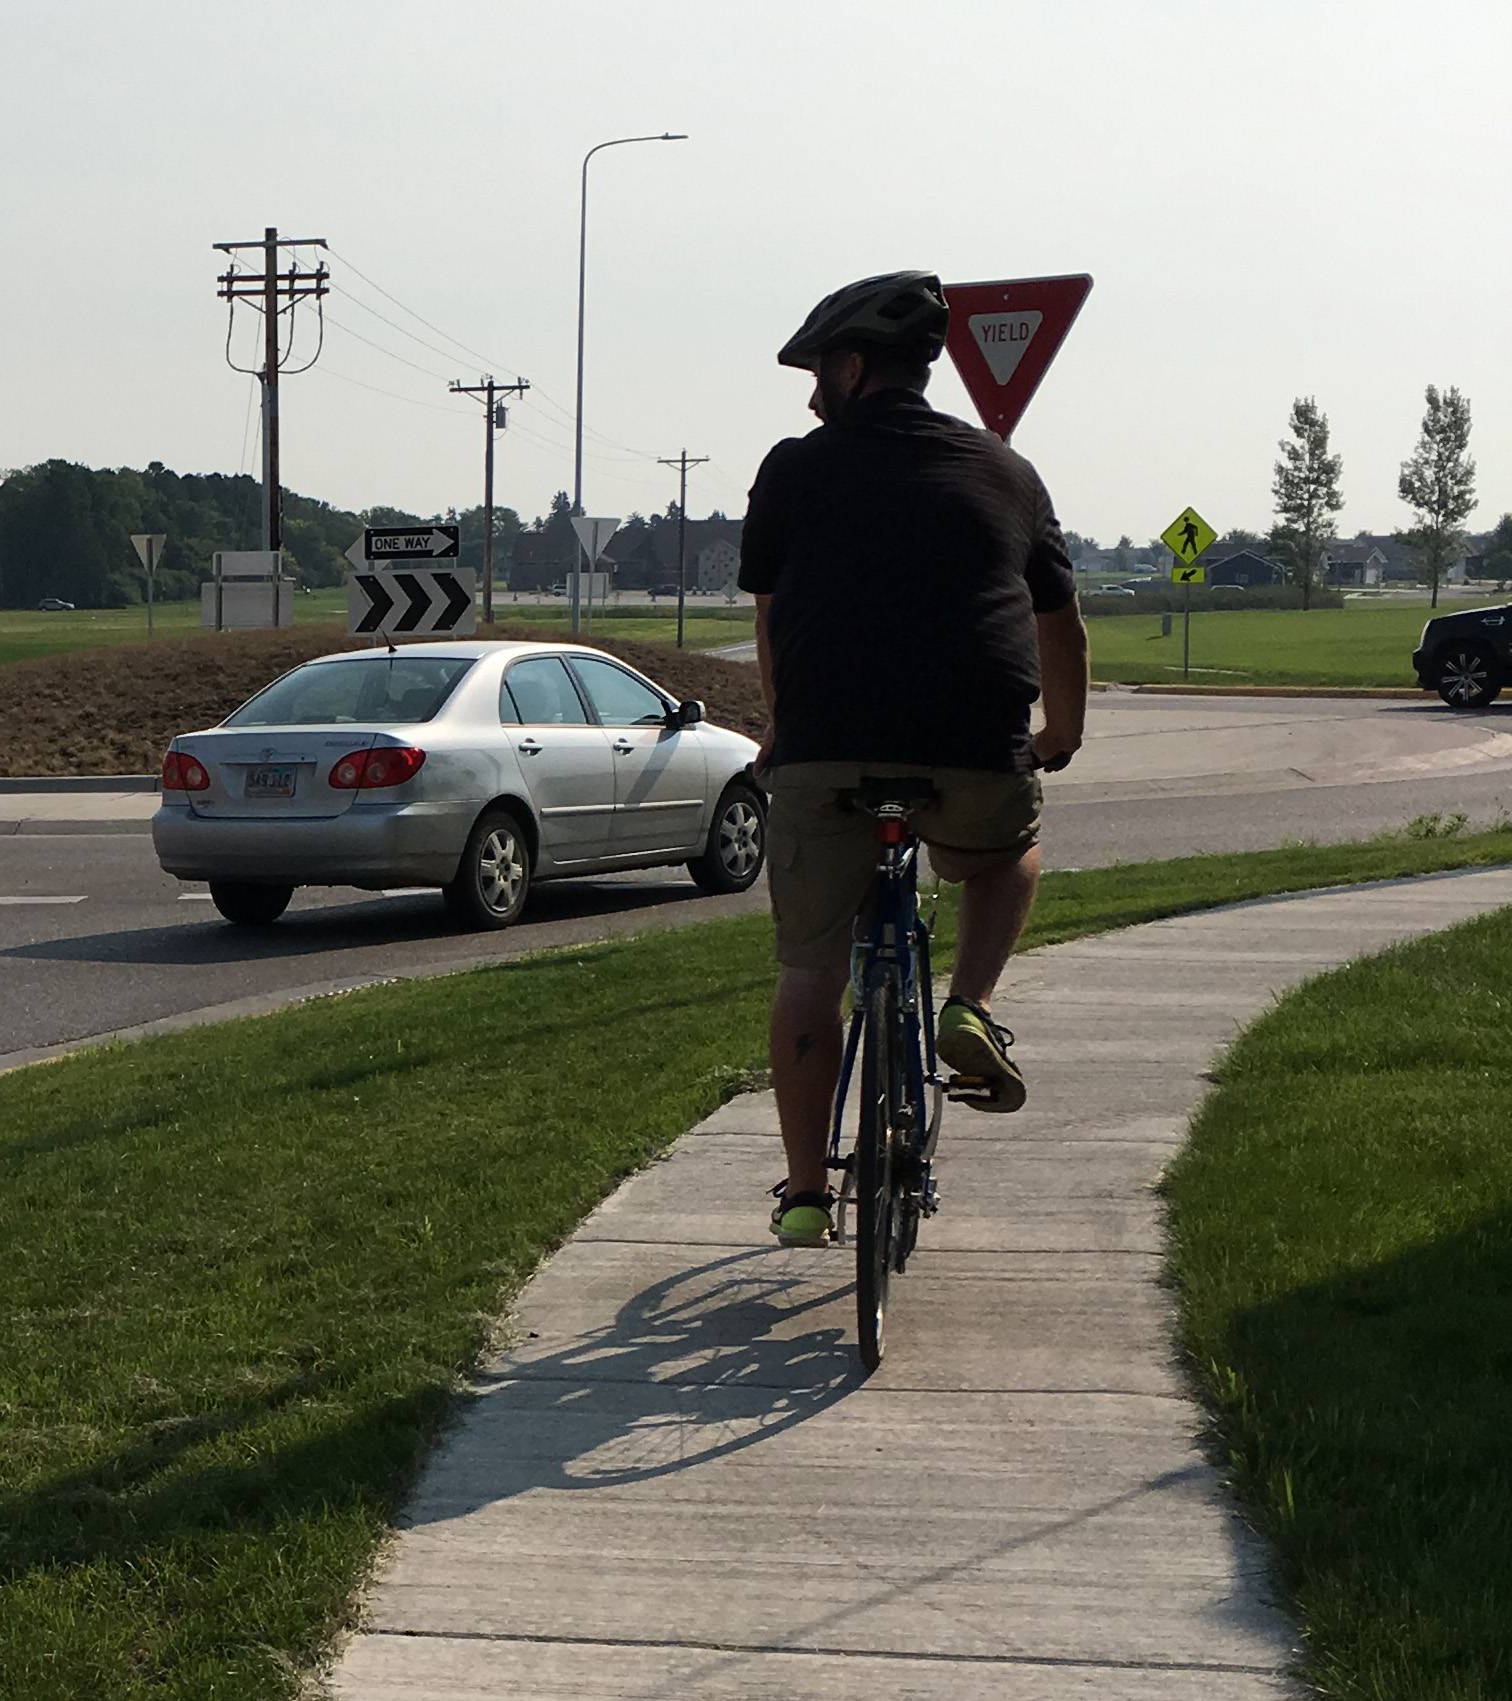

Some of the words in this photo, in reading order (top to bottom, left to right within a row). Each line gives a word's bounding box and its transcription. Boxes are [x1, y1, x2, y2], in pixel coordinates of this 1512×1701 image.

[982, 322, 1029, 343] YIELD
[375, 537, 400, 550] ONE
[404, 536, 430, 549] WAY
